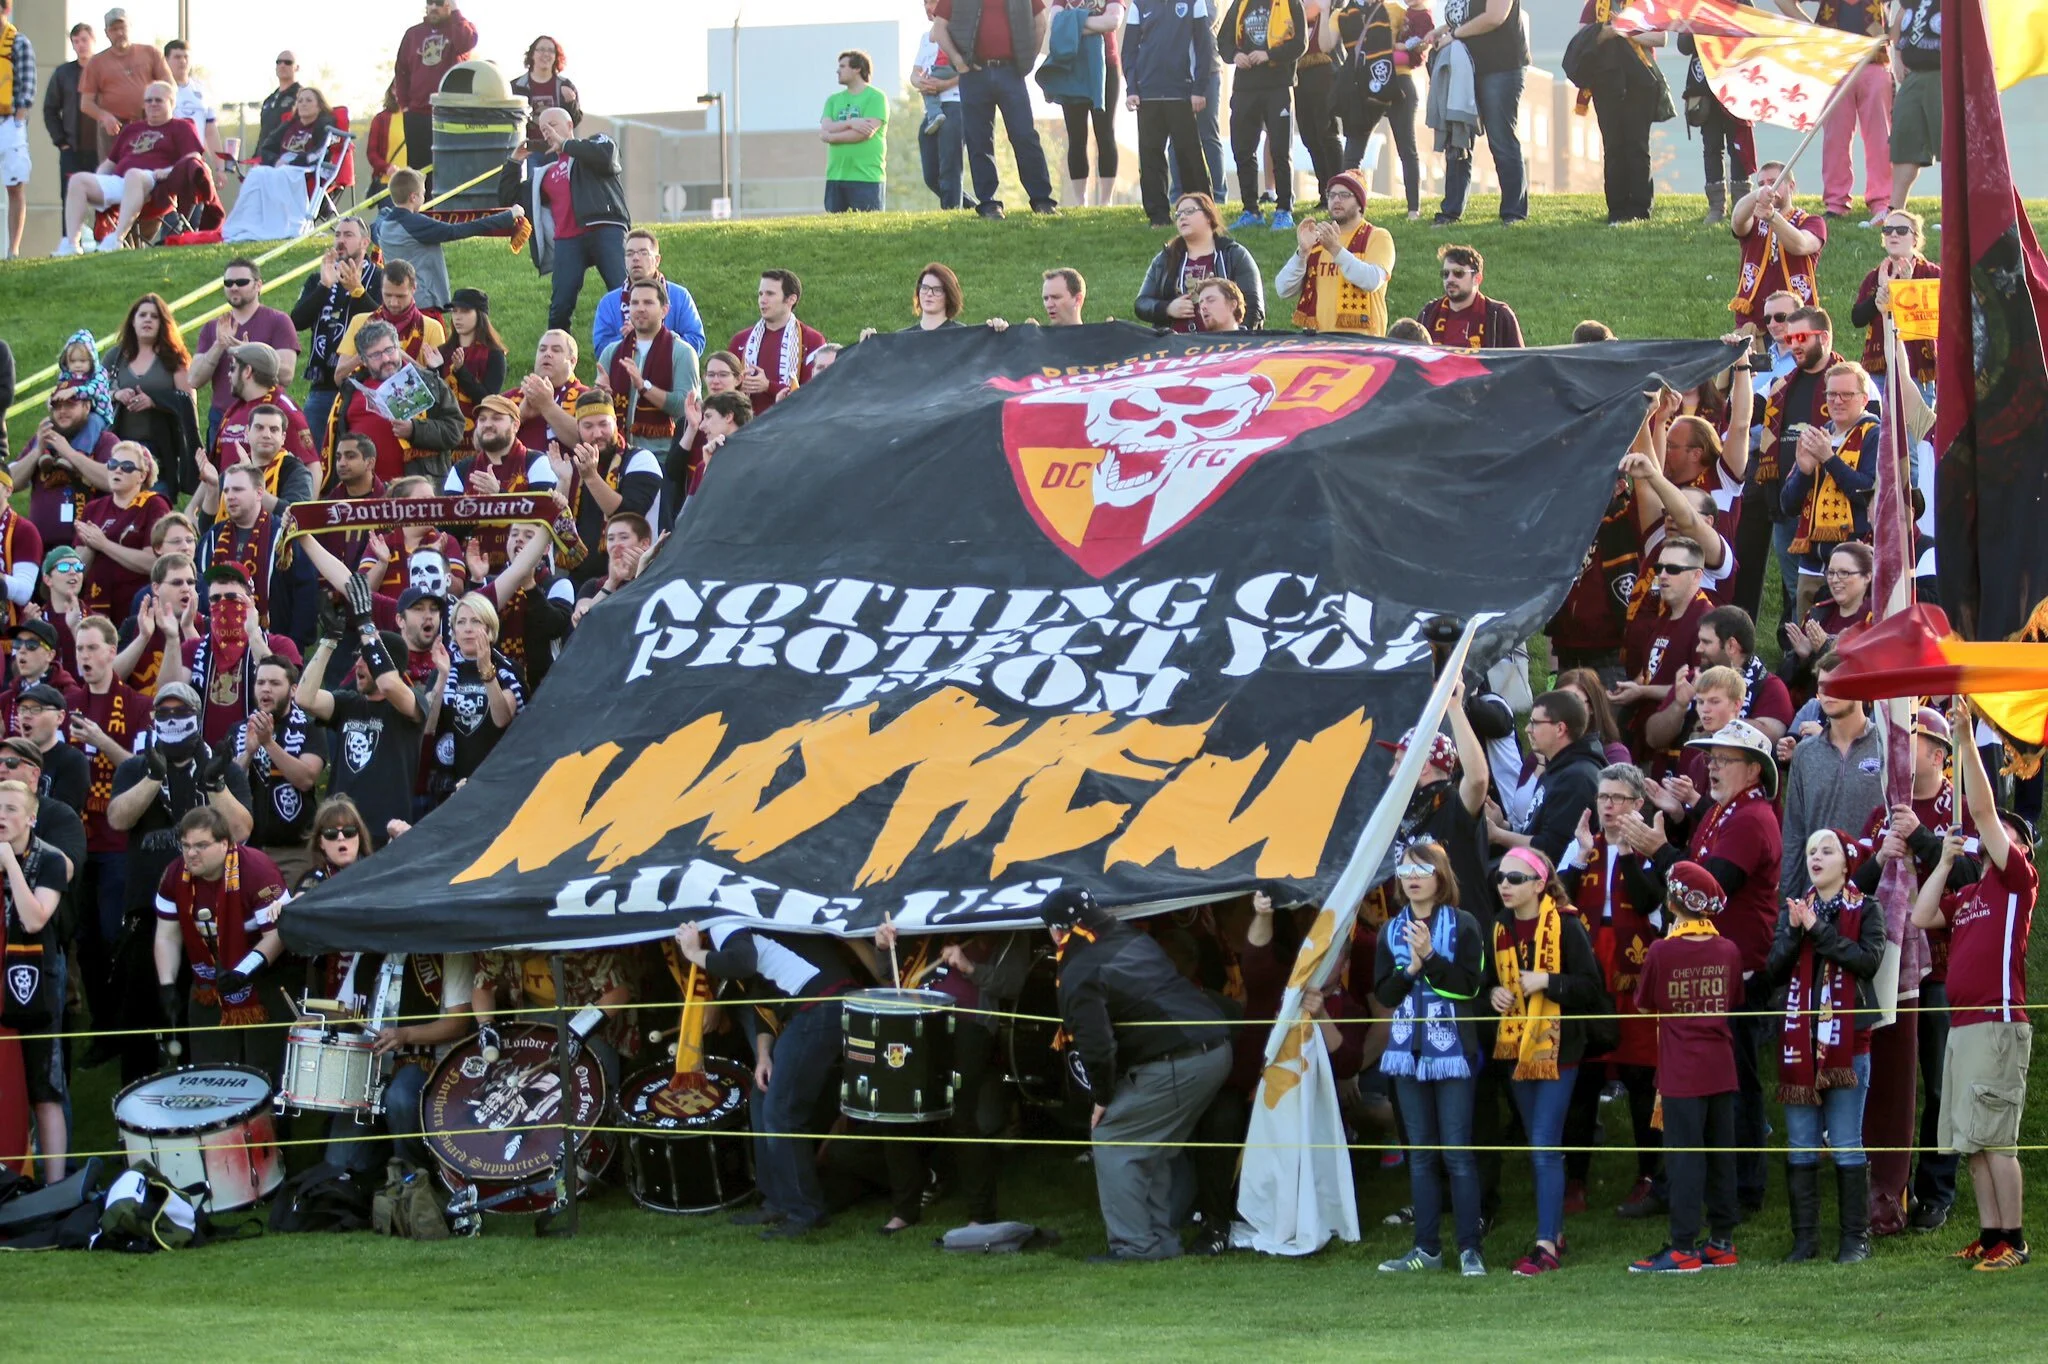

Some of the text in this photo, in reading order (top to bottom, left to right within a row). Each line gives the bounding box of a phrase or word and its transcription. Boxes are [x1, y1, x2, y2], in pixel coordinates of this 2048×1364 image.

[1041, 349, 1169, 378] DETROIT
[1184, 341, 1252, 356] CITY
[1290, 364, 1351, 402] G
[1041, 460, 1093, 490] DC
[326, 500, 445, 525] Northern
[454, 496, 535, 518] Guard
[634, 573, 1219, 635] NOTHING
[625, 617, 1201, 684] PROTECT
[822, 654, 1191, 717] FROM
[450, 685, 1374, 890] WOMEN
[548, 859, 1063, 932] LIKE US
[1672, 967, 1701, 979] CHEVY
[502, 1037, 549, 1050] Louder
[1784, 976, 1802, 1063] IF THEY
[179, 1076, 249, 1088] YAMAHA
[575, 1065, 595, 1122] Our Foes
[432, 1067, 550, 1174] Northern Guard Supporters
